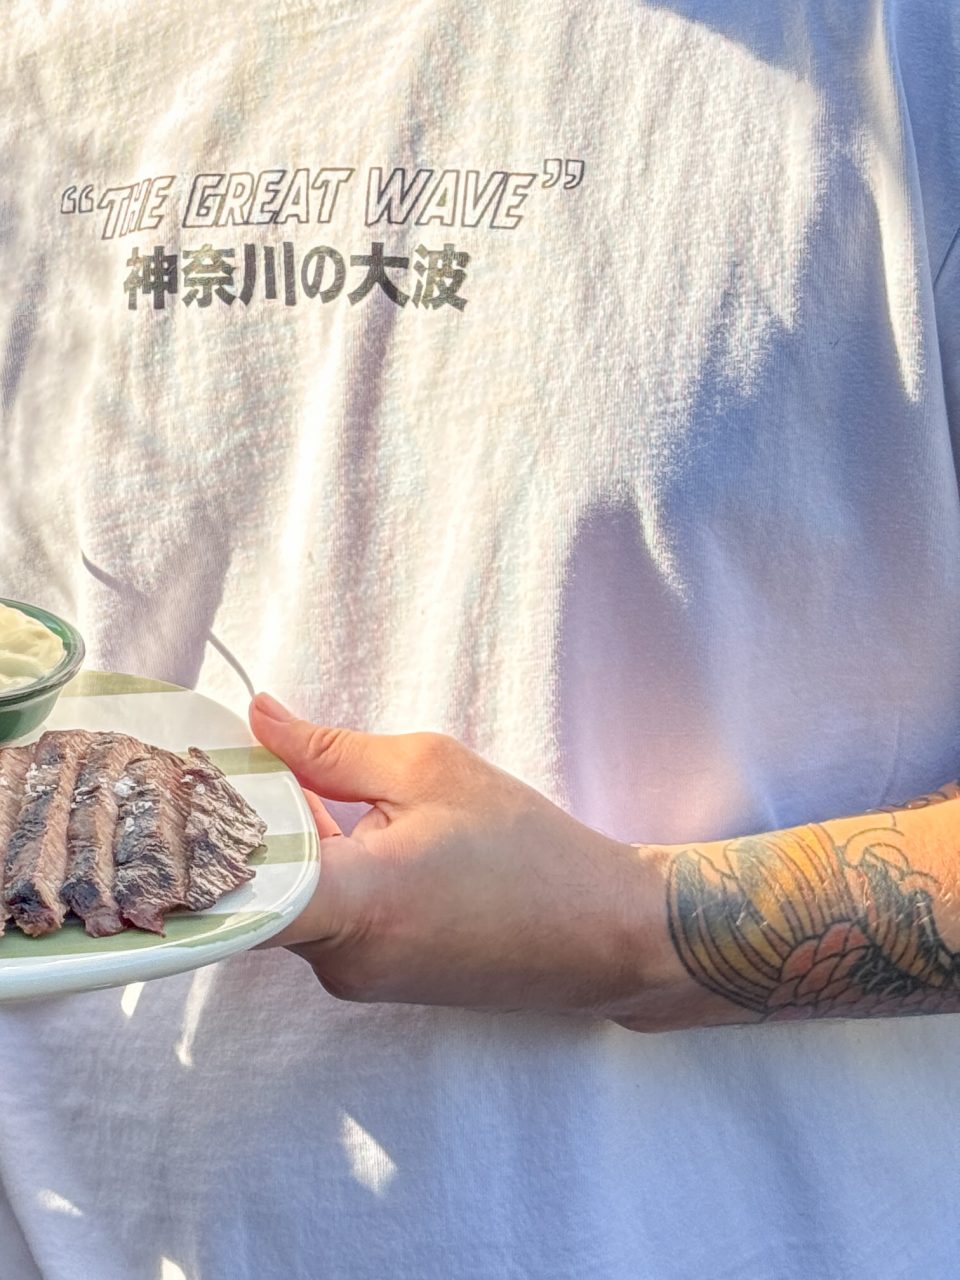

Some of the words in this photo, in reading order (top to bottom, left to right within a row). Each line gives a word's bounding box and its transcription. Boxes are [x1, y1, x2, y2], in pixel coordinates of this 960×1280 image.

[181, 167, 356, 229] GREAT
[123, 241, 472, 312] 神奈川の大波
